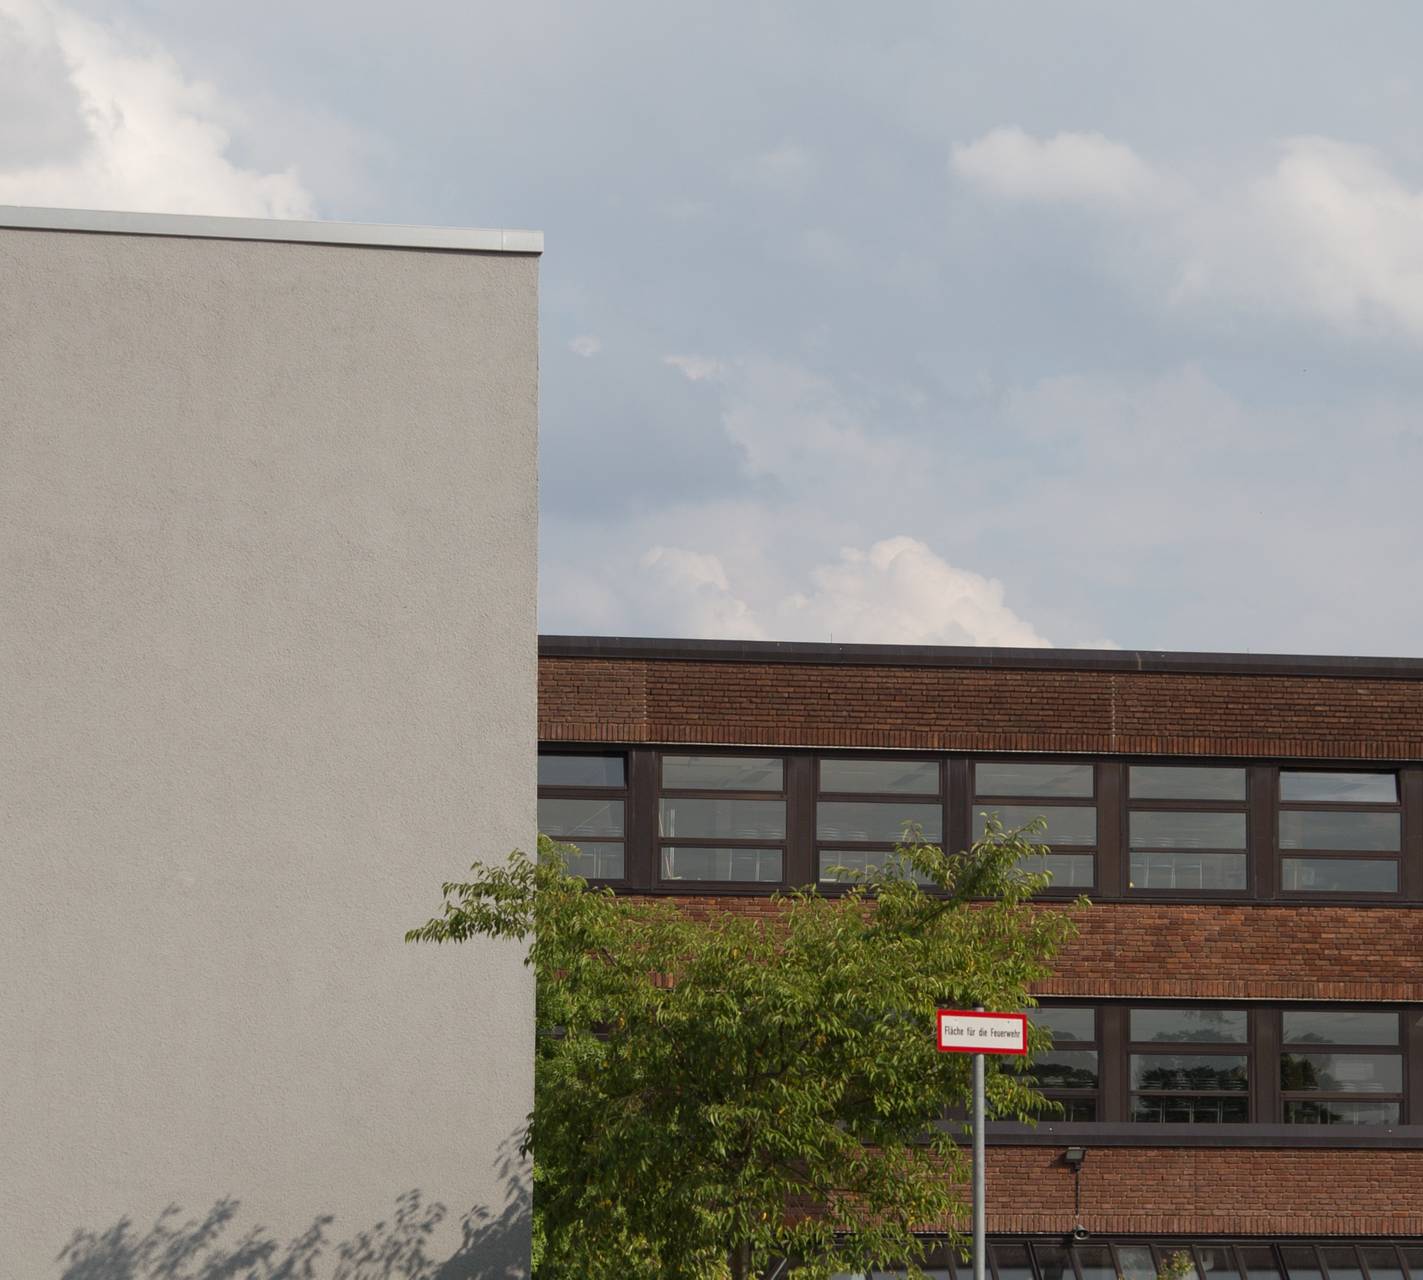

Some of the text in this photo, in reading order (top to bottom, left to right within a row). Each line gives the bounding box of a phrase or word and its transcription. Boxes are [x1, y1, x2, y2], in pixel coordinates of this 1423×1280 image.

[944, 1025, 1020, 1038] Fläche für die Feuerwehr
